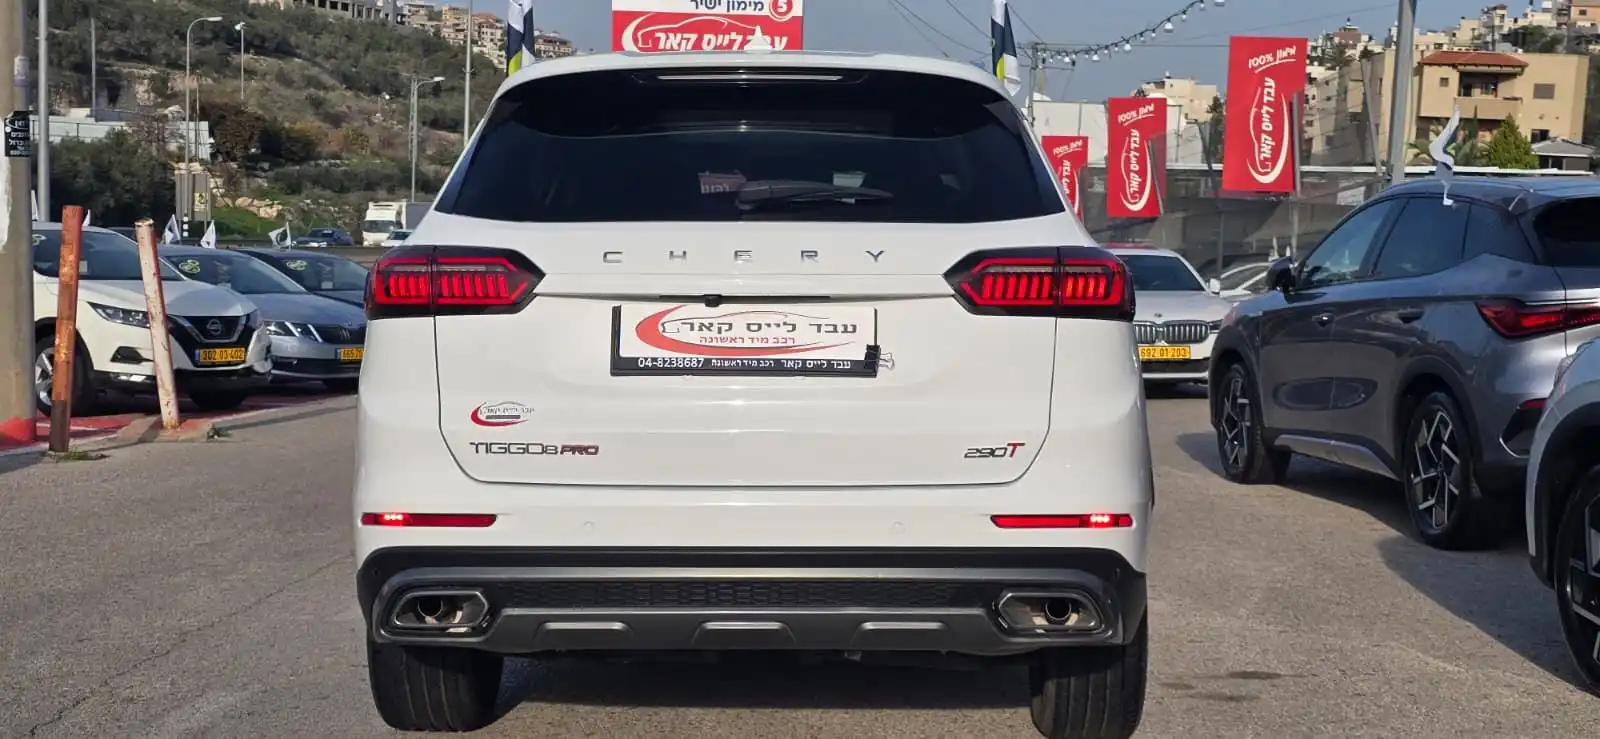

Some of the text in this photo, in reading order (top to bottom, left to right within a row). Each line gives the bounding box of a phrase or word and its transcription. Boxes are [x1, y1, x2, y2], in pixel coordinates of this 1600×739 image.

[726, 0, 764, 12] מימון
[654, 32, 699, 51] קאר
[1248, 53, 1274, 68] 100%
[1263, 77, 1276, 104] עבד
[1118, 110, 1138, 124] 100%
[1260, 133, 1276, 161] קאר
[603, 250, 885, 264] CHERY
[681, 321, 857, 335] עבד לייס קאר
[699, 336, 795, 345] רכב מיד ראשונה
[638, 358, 705, 368] 04-8238687
[780, 360, 802, 370] קאר
[829, 361, 851, 369] עבד
[560, 445, 600, 455] PRO
[964, 443, 1026, 458] 290T
